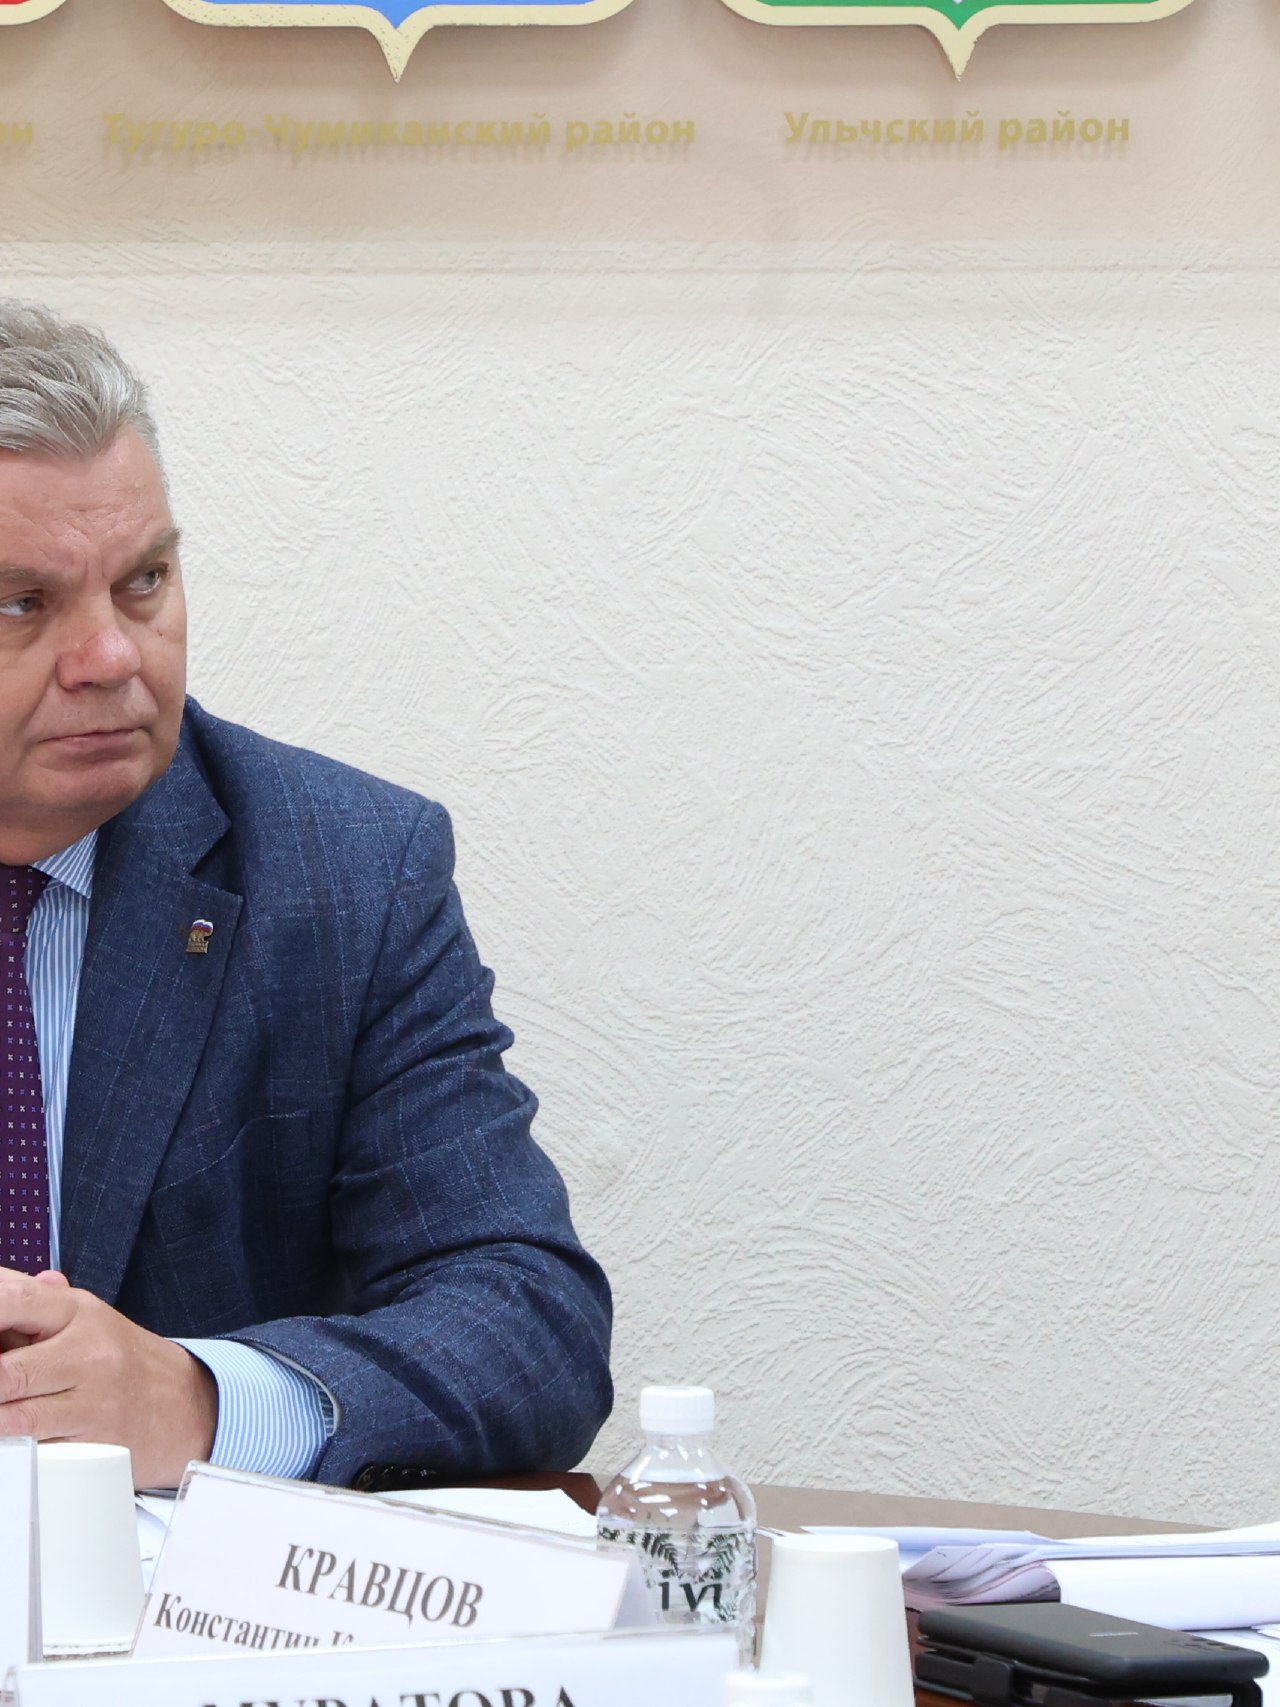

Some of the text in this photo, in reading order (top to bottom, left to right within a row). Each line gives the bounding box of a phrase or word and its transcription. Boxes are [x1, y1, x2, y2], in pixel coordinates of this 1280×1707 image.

[103, 111, 695, 154] Тугуро-Чумиканский район
[783, 110, 1130, 150] Ульчский район
[276, 1544, 484, 1629] КРАВЦОВ
